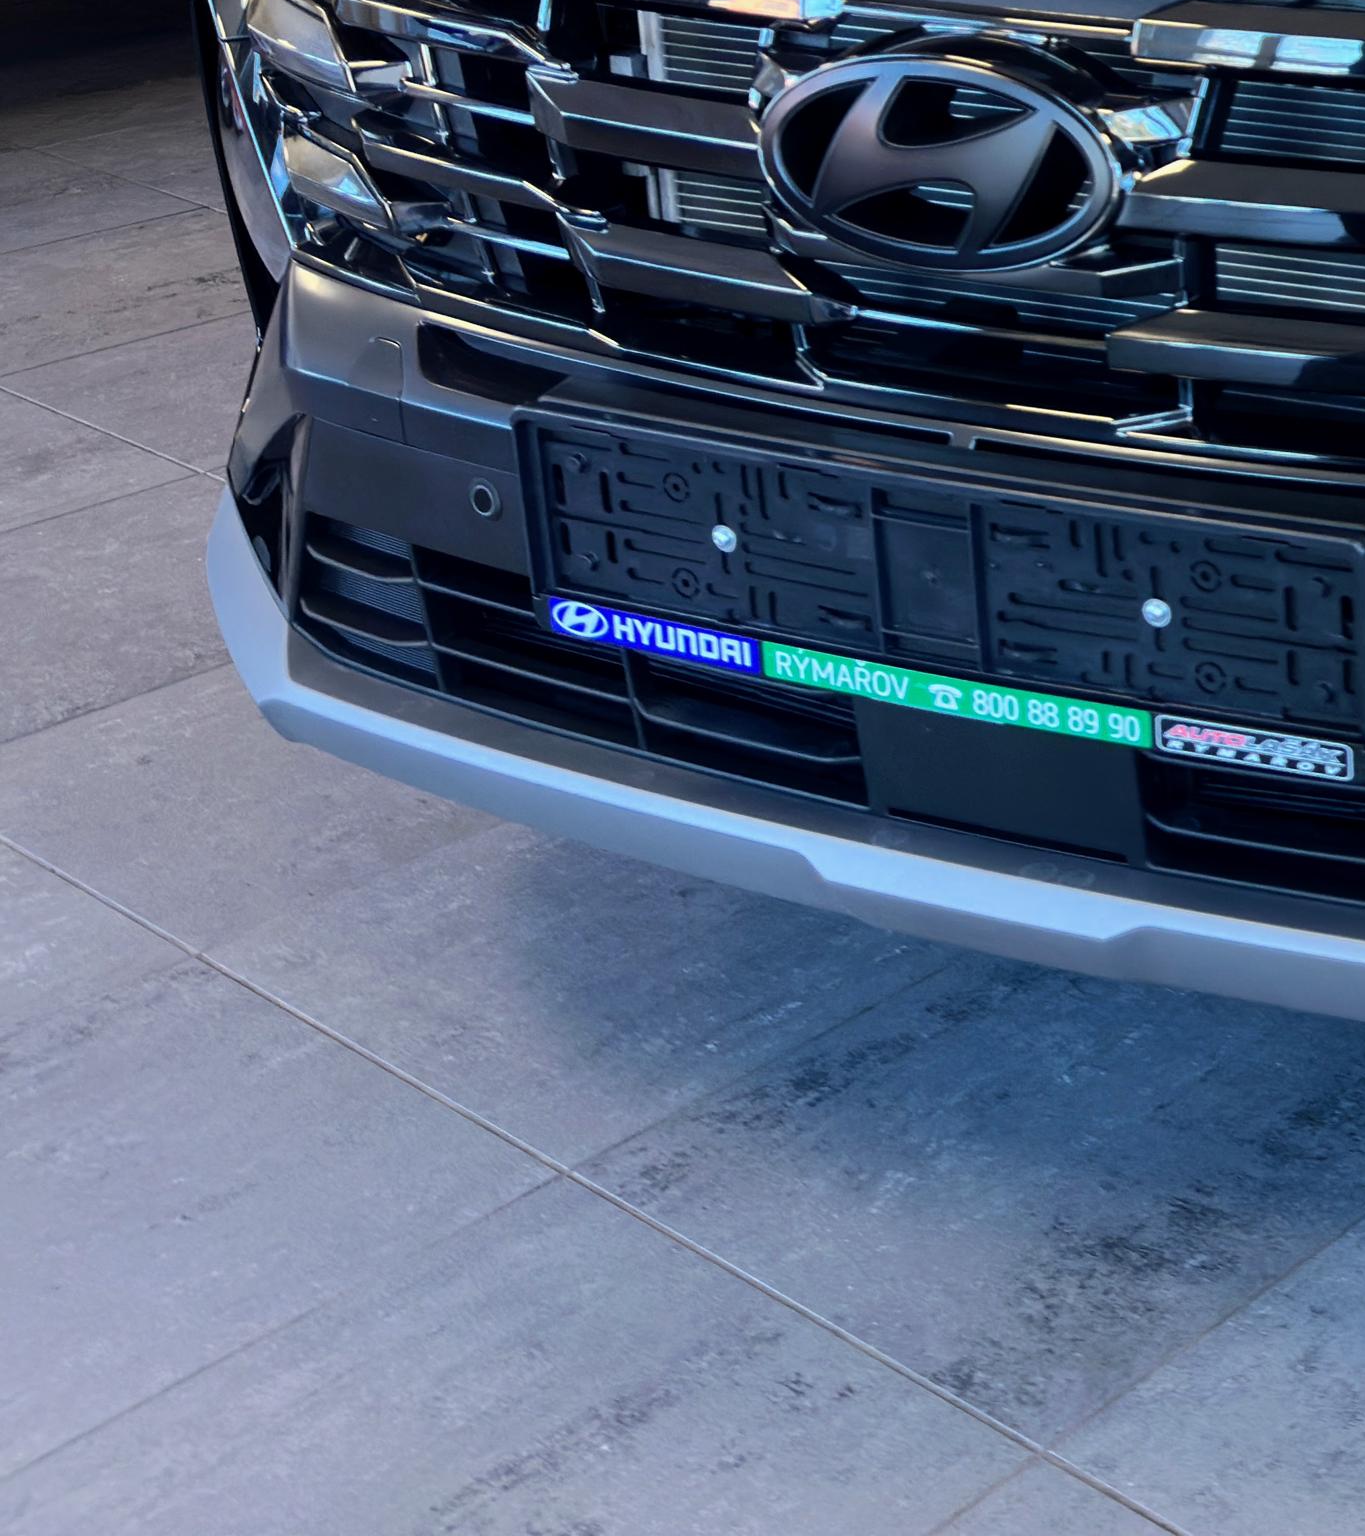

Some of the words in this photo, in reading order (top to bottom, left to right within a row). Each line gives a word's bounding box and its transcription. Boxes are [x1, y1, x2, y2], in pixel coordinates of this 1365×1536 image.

[612, 613, 752, 668] HYUNDAI
[773, 647, 910, 700] RÝMAŘOV
[971, 688, 1020, 722] 800
[1026, 698, 1061, 729] 88
[1066, 706, 1100, 736] 89
[1107, 713, 1141, 742] 90
